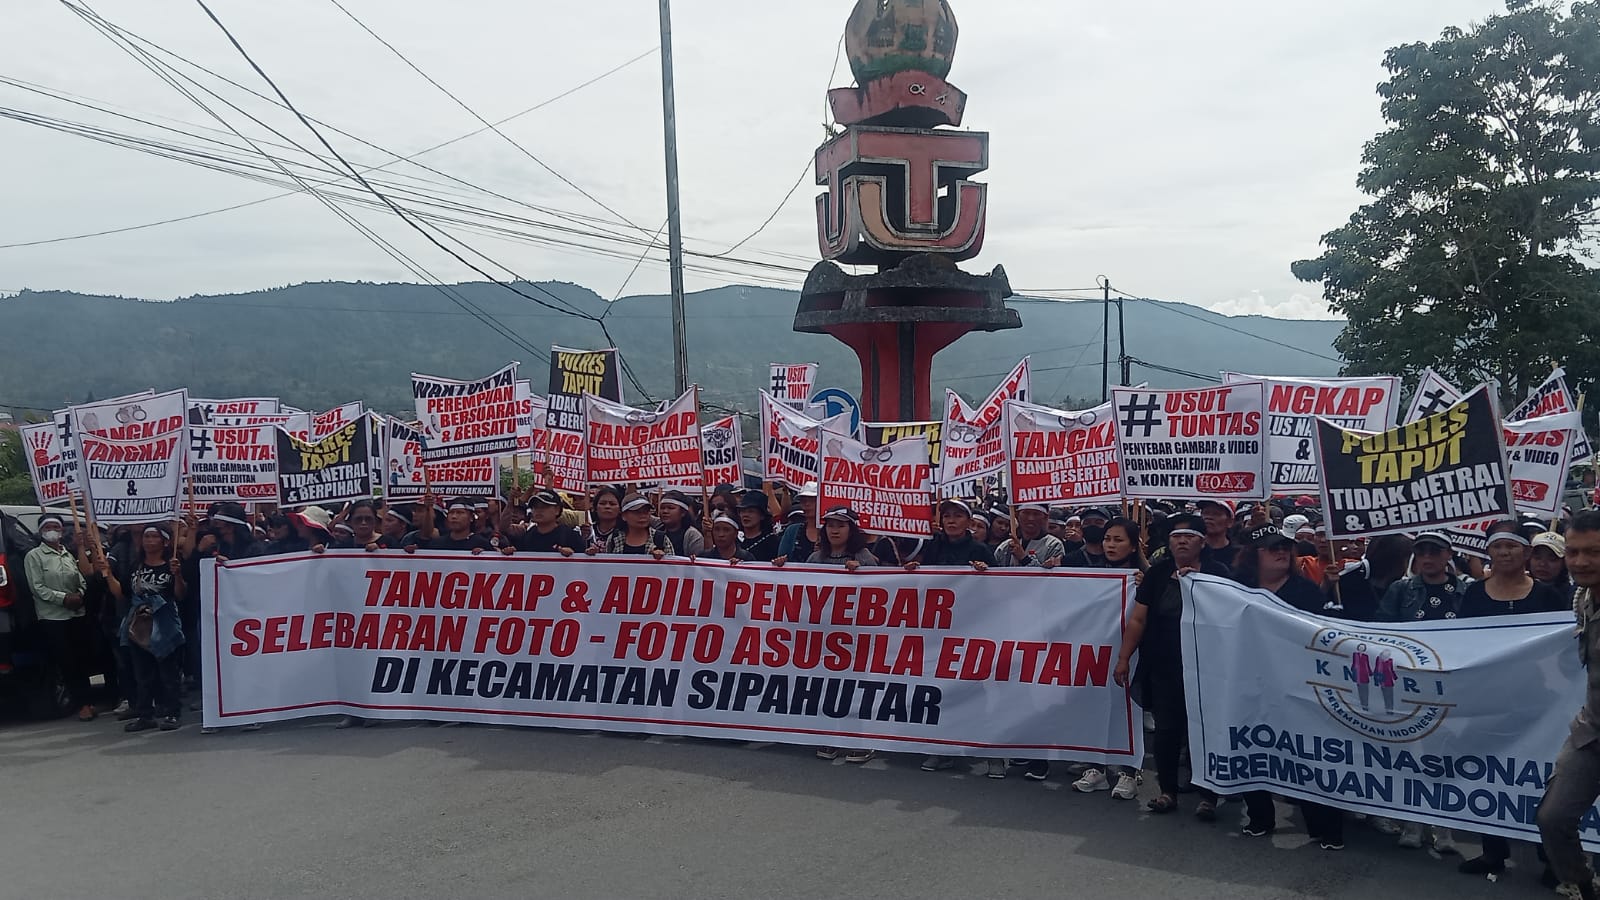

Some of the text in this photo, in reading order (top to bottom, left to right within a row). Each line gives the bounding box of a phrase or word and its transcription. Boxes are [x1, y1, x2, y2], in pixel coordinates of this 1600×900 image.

[562, 371, 603, 397] TAPUT
[787, 366, 808, 383] USUT
[427, 386, 513, 413] PEREMPUAN
[1164, 389, 1232, 413] USUT
[441, 401, 515, 428] BERSUARA
[547, 412, 557, 426] &
[1119, 394, 1162, 437] #
[1167, 411, 1261, 437] TUNTAS
[87, 415, 183, 440] ANGKAP
[213, 428, 262, 445] USUT
[441, 418, 517, 442] & BERSATU
[589, 411, 696, 447] TANGKAP
[1341, 402, 1469, 454] POLRES
[449, 445, 473, 456] HARUS
[590, 437, 699, 460] BANDAR NARKOBA
[1123, 440, 1259, 455] PENYEBAR GAMBAR & VIDEO
[1296, 439, 1310, 460] &
[1356, 430, 1466, 484] TAPUT
[1512, 449, 1559, 466] & VIDEO
[92, 463, 124, 479] TULUS
[220, 462, 253, 472] GAMBAR
[253, 464, 259, 473] &
[591, 467, 629, 480] ANTEK
[638, 462, 701, 478] ANTEKNYA
[619, 453, 671, 469] BESERTA
[1016, 456, 1073, 475] BANDAR
[1125, 457, 1221, 471] PORNOGRAFI EDITAN
[229, 474, 257, 484] EDITAN
[321, 462, 368, 483] NETRAL
[411, 468, 493, 482] & BERSATU
[704, 464, 739, 487] DESA
[823, 456, 930, 490] TANGKAP
[1051, 465, 1110, 484] BESERTA
[1127, 474, 1248, 490] & KONTEN HOAX
[127, 480, 138, 496] &
[194, 485, 236, 495] KONTEN
[287, 479, 363, 502] & BERPIHAK
[446, 487, 493, 495] DITEGAKKAN
[824, 485, 872, 501] BANDAR
[875, 490, 931, 507] NARKOBA
[1018, 485, 1063, 501] ANTEK
[1329, 462, 1505, 510] TIDAK NETRAL
[851, 500, 903, 517] BESERTA
[1345, 515, 1365, 532] &
[1368, 487, 1500, 529] BERPIHAK
[870, 517, 931, 533] ANTEKNYA
[365, 570, 955, 630] TANGKAP & ADILI PENYEBAR
[231, 612, 1113, 687] SELEBARAN FOTO - FOTO ASUSILA EDITAN
[371, 656, 942, 725] DI KECAMATAN SIPAHUTAR
[1324, 688, 1439, 737] PEREMPUAN INDONESIA
[1229, 724, 1354, 765] KOALISI
[1208, 752, 1600, 836] PEREMPUAN INDONEA
